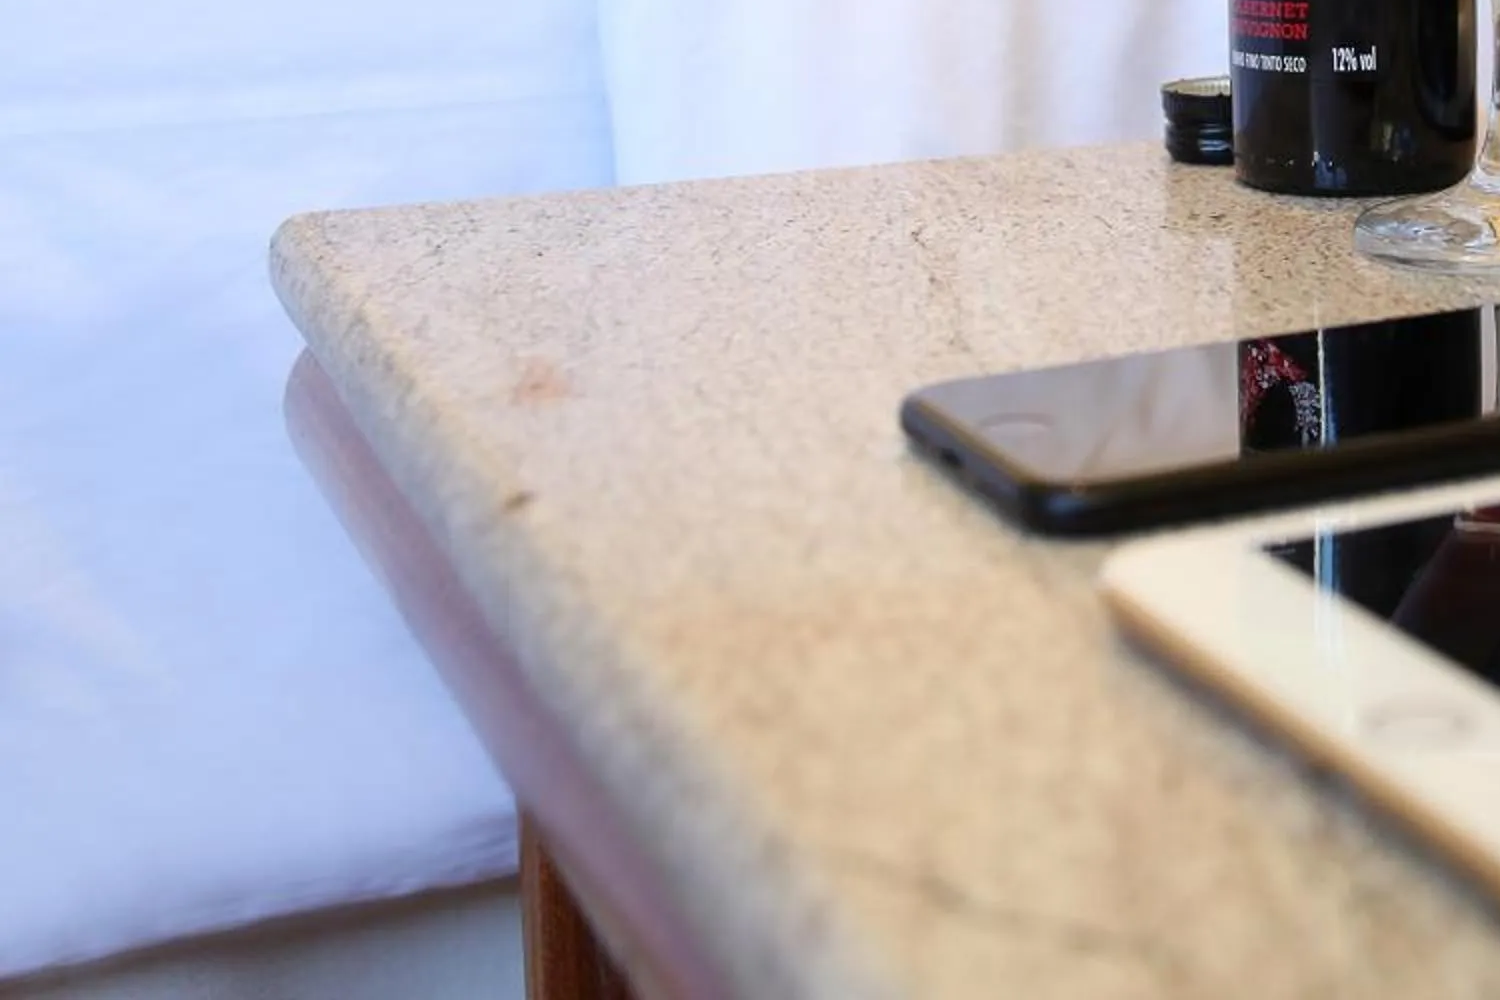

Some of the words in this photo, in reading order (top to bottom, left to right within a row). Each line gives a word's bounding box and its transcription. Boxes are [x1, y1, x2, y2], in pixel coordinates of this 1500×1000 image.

[1283, 56, 1307, 73] SECO
[1332, 47, 1358, 72] 12%
[1359, 45, 1377, 71] vol
